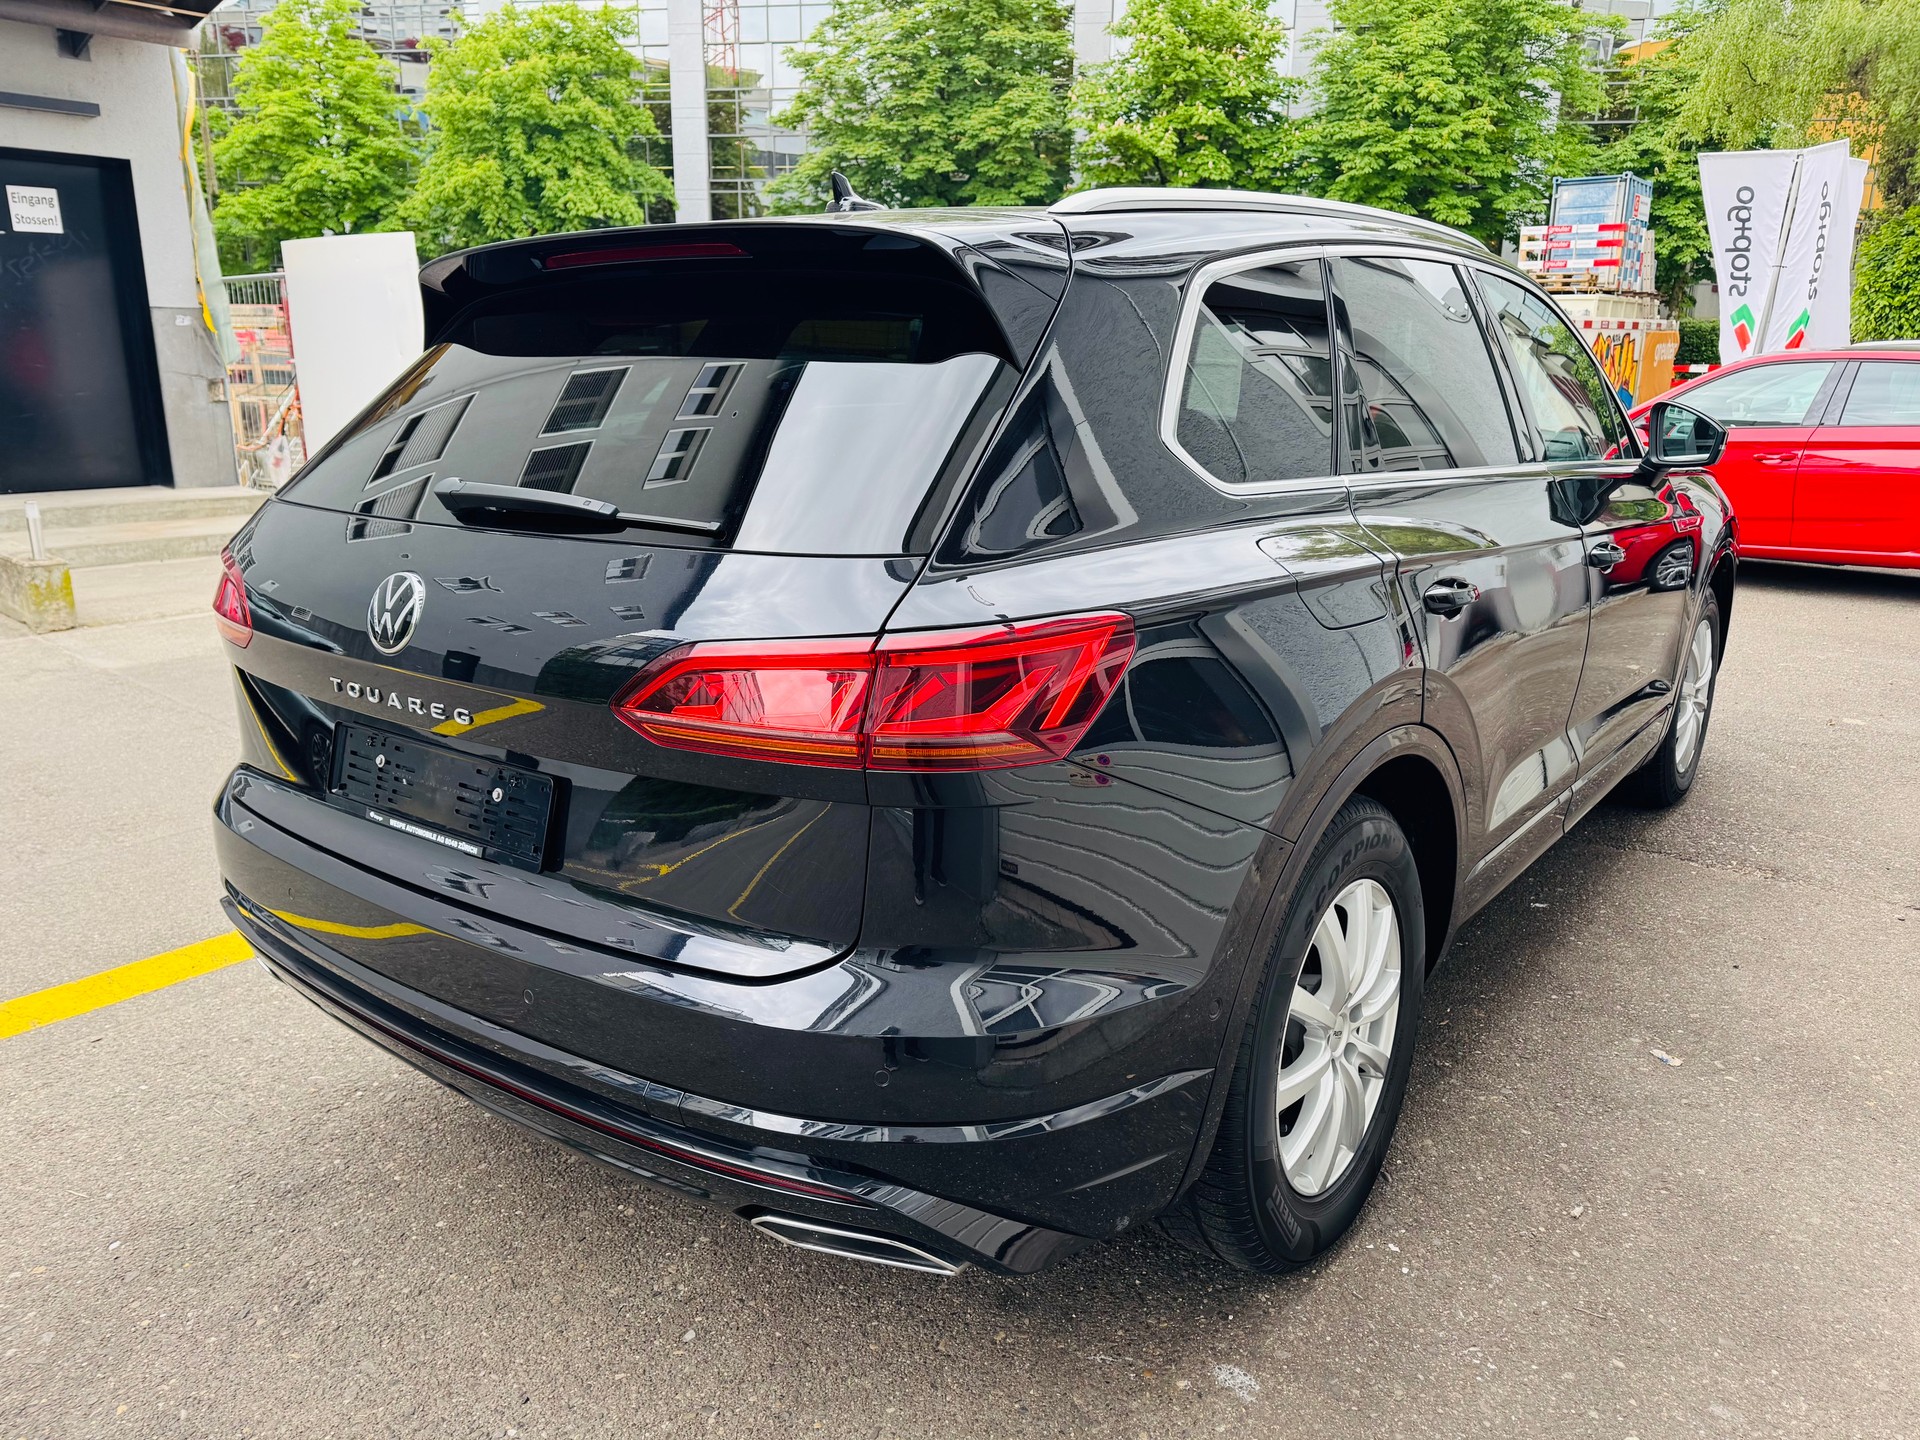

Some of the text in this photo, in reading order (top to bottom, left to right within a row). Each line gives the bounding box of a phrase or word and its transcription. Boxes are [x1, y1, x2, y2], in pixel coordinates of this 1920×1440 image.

[10, 191, 55, 209] Eingang
[14, 213, 59, 226] Stossen!
[329, 676, 474, 726] TOUAREG
[406, 824, 437, 841] AUTOMOBILE
[1303, 833, 1393, 940] SCORPION
[1265, 1183, 1302, 1250] PIRELLI
